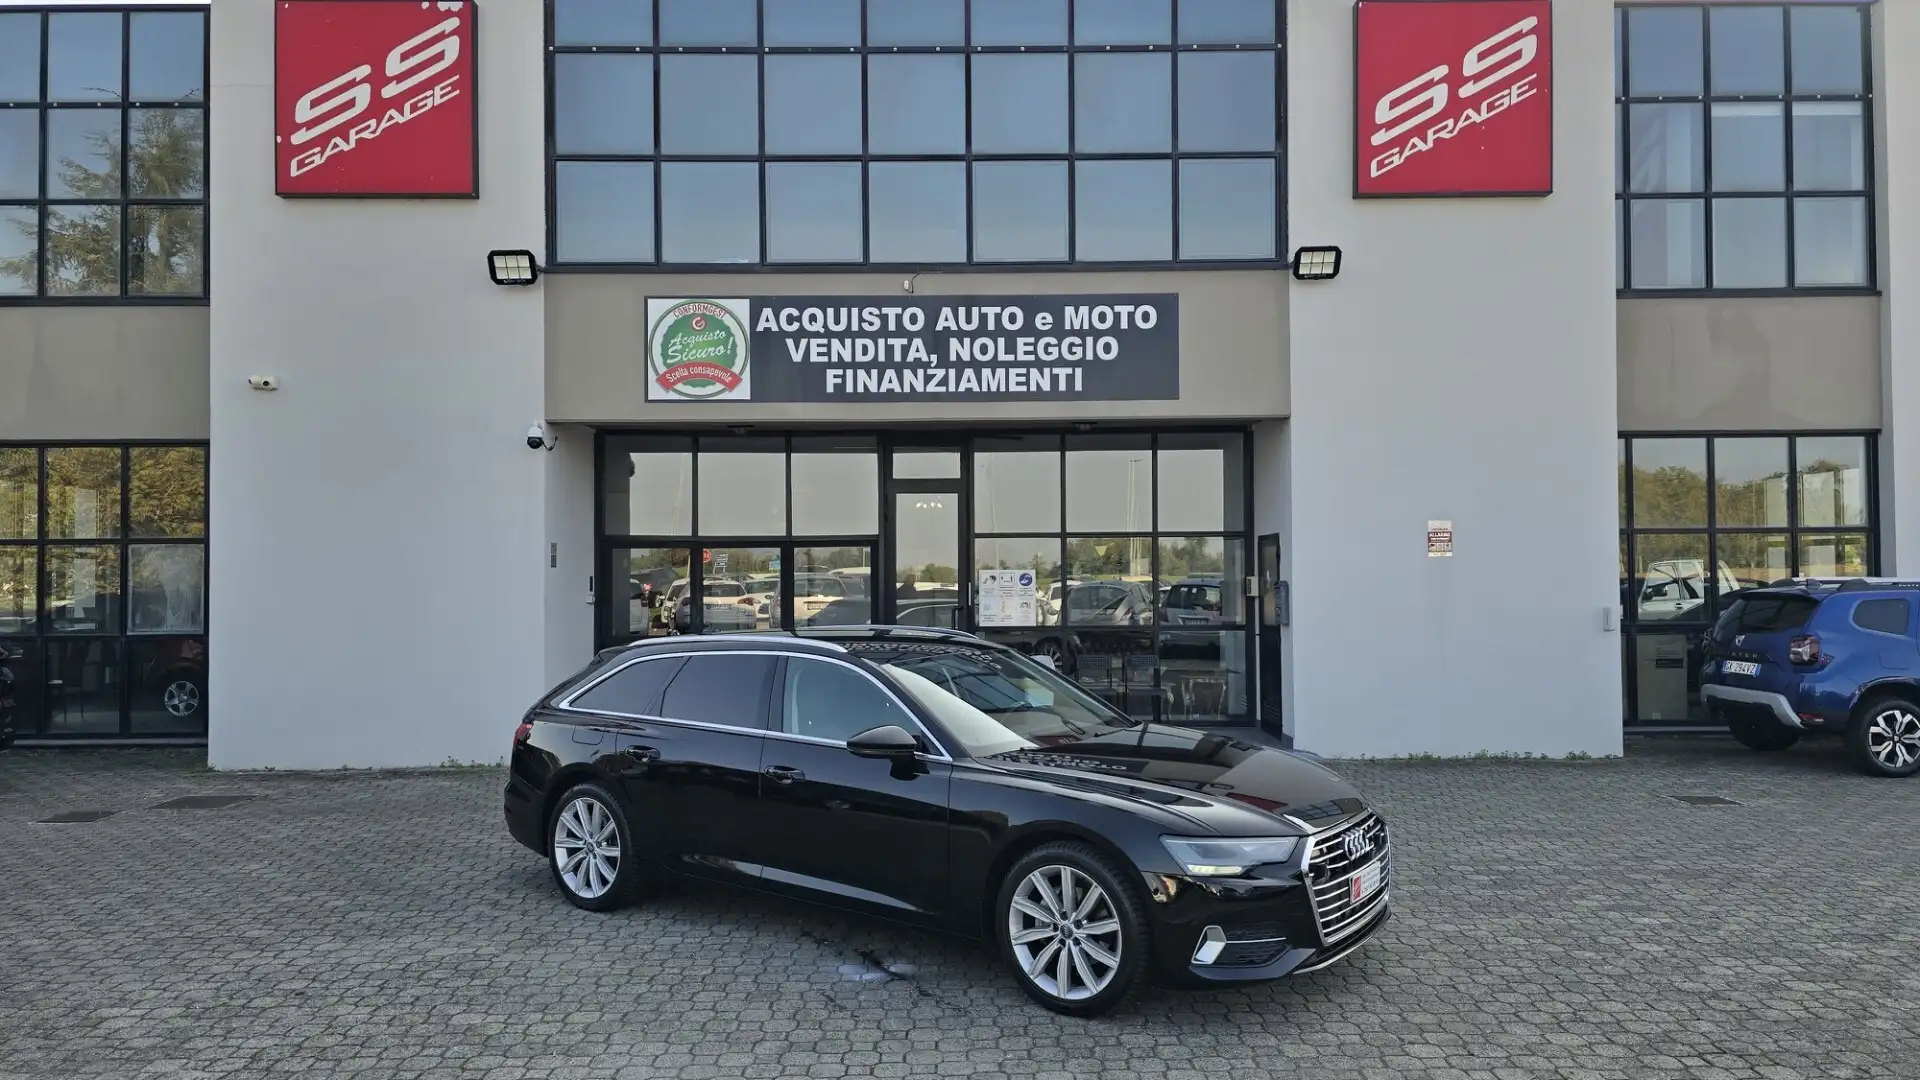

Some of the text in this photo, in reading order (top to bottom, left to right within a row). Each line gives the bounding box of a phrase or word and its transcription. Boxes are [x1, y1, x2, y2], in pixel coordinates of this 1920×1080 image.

[290, 74, 460, 177] GARAGE
[1370, 73, 1538, 178] GARAGE
[756, 305, 1158, 333] ACQUISTO AUTO e MOTO
[667, 336, 733, 363] Sicuro!
[668, 329, 727, 348] Acquisto
[785, 336, 1119, 367] VENDITA, NOLEGGIO
[665, 366, 733, 383] Scelta consapevole
[826, 367, 1083, 393] FINANZIAMENTI
